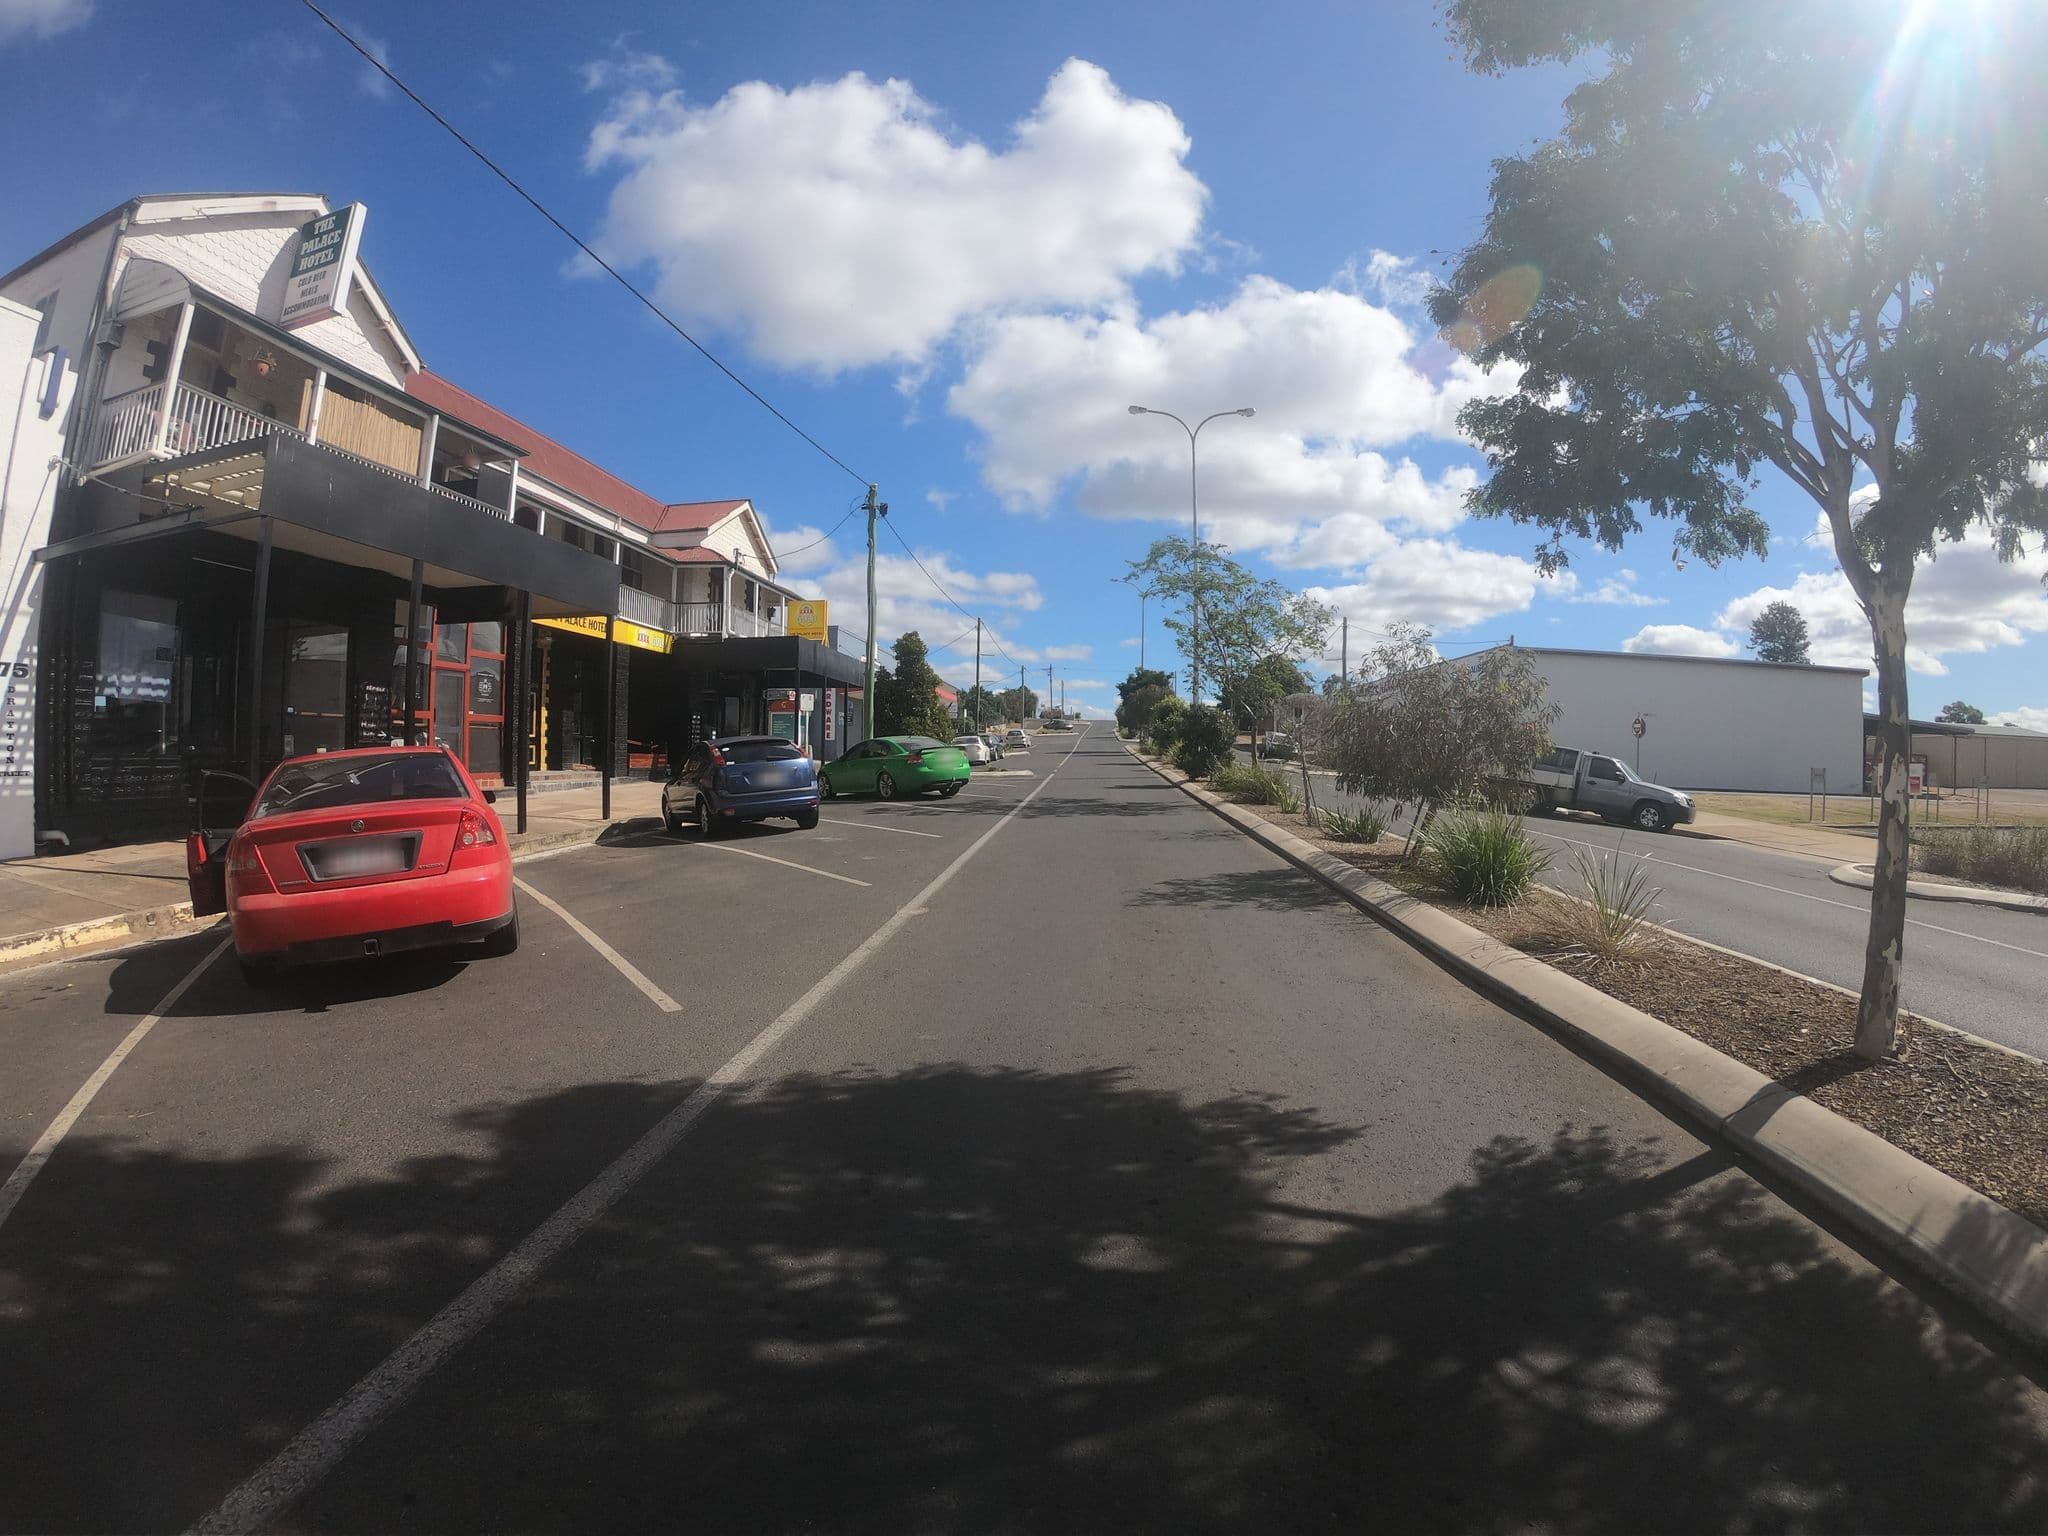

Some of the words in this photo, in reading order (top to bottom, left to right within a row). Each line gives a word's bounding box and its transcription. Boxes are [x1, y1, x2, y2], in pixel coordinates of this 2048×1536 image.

[313, 216, 336, 235] THE
[300, 229, 342, 256] PALACE
[298, 248, 334, 271] HOTEL
[283, 294, 331, 316] ACCOMMODATION
